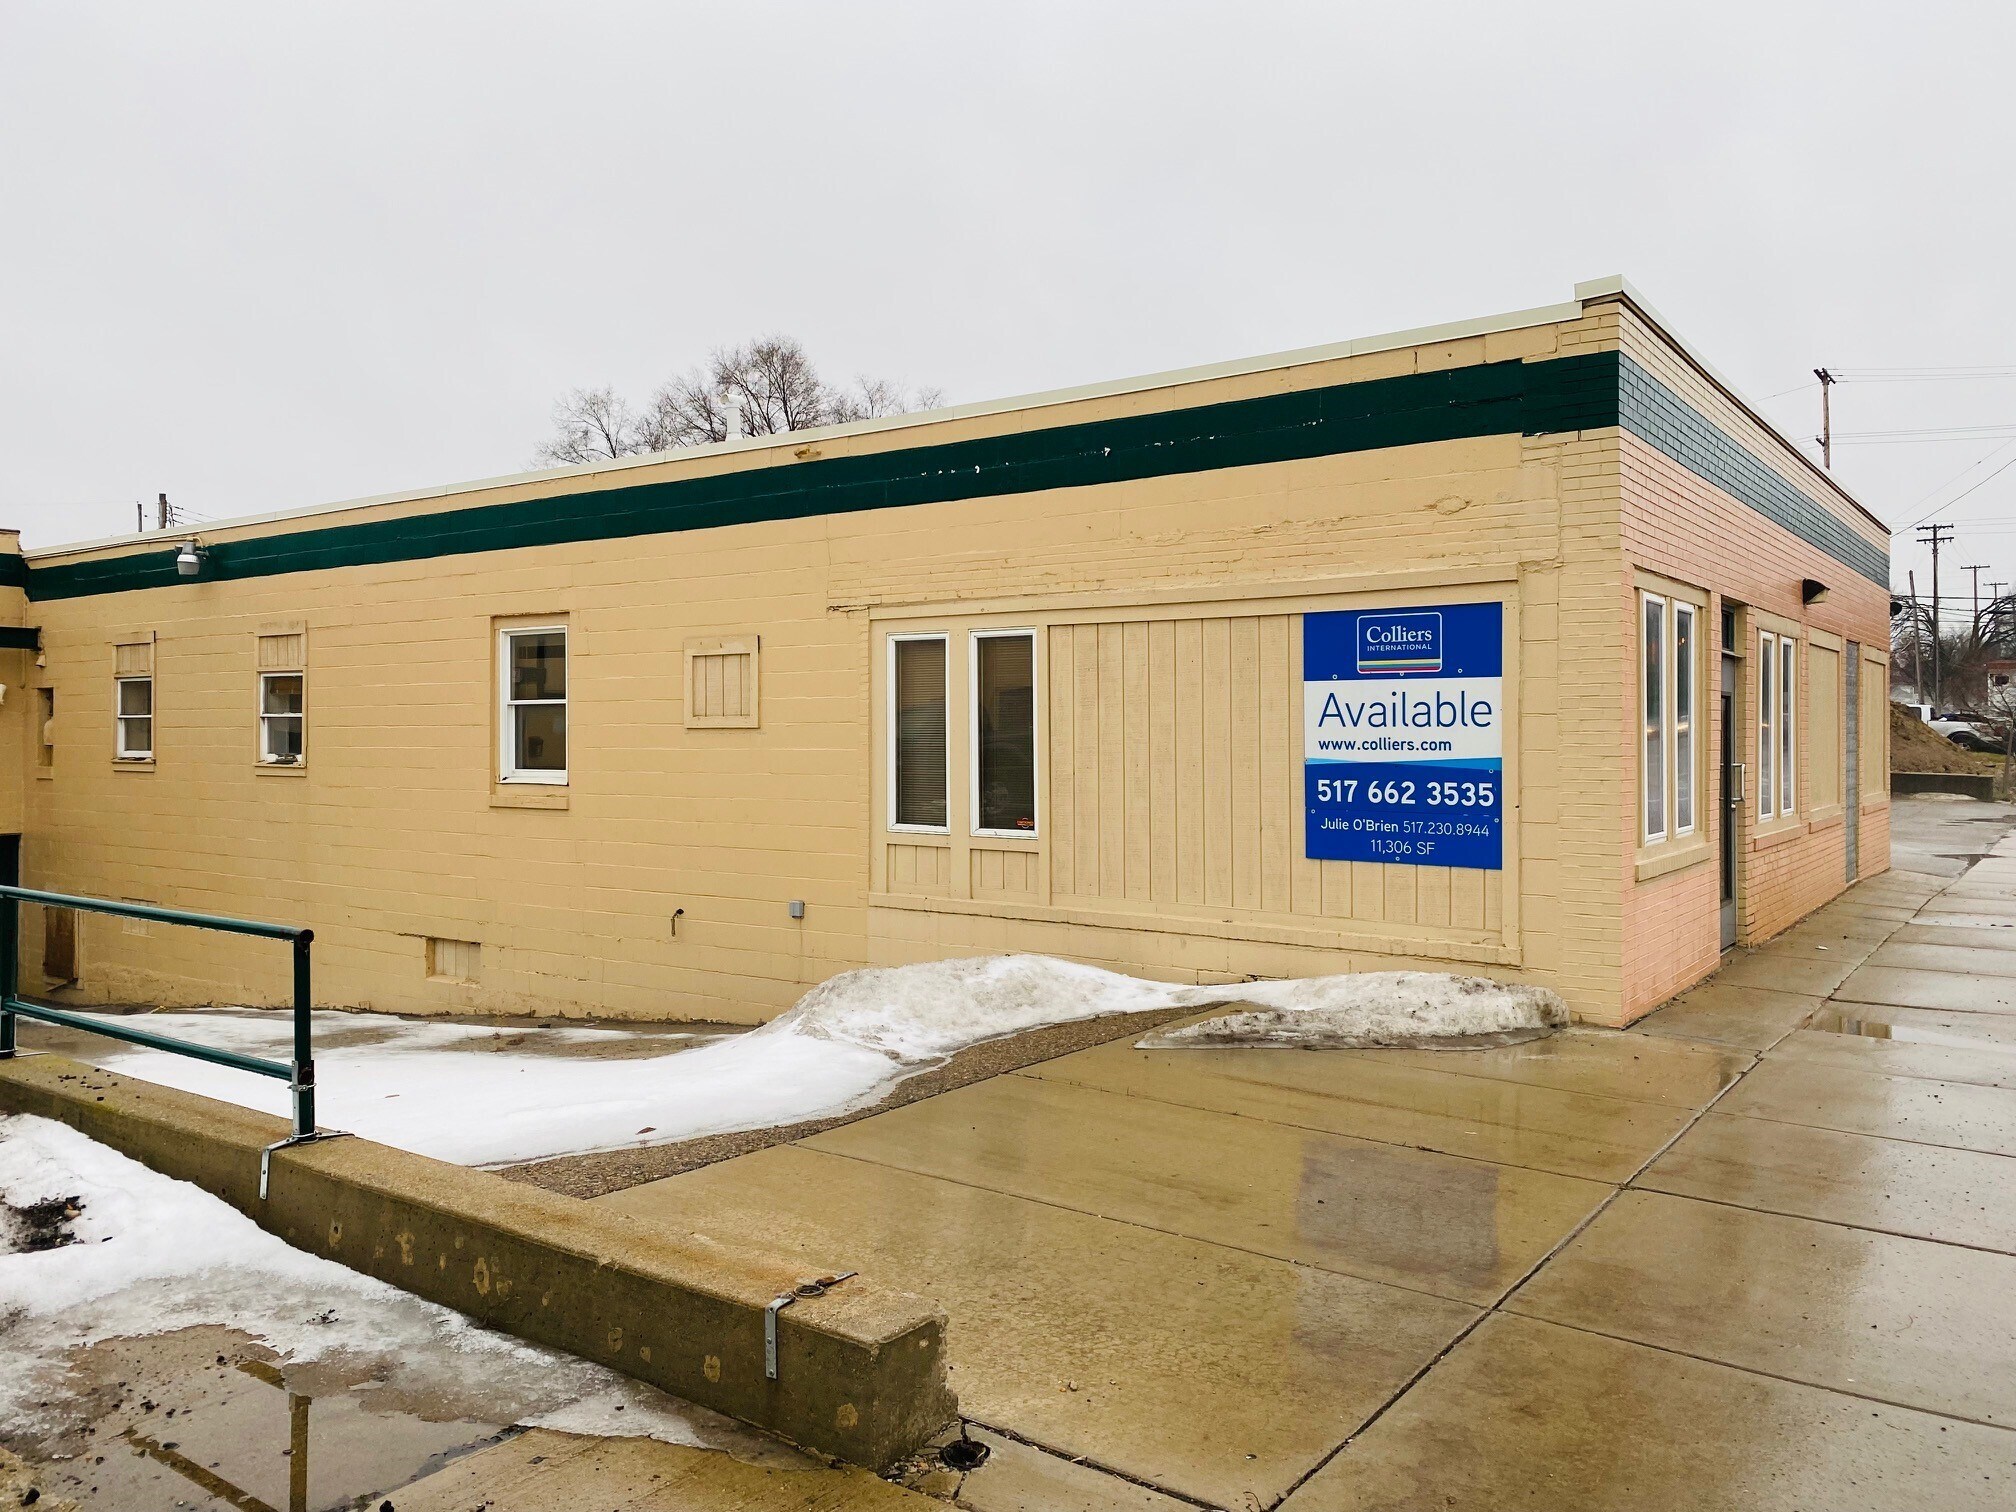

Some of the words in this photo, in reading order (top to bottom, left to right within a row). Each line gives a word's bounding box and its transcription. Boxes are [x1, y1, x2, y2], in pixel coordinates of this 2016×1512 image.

[1366, 625, 1432, 644] Colliers
[1367, 643, 1432, 652] INTERNATIONAL
[1318, 690, 1493, 728] Available
[1318, 737, 1452, 751] www.colliers.com
[1317, 779, 1358, 802] 517
[1367, 780, 1416, 804] 662
[1426, 782, 1495, 807] 3535
[1320, 817, 1350, 831] Julie
[1353, 819, 1399, 833] O'Brien
[1403, 821, 1490, 837] 517.230.8944
[1370, 839, 1412, 855] 11,306
[1416, 842, 1435, 855] SF
